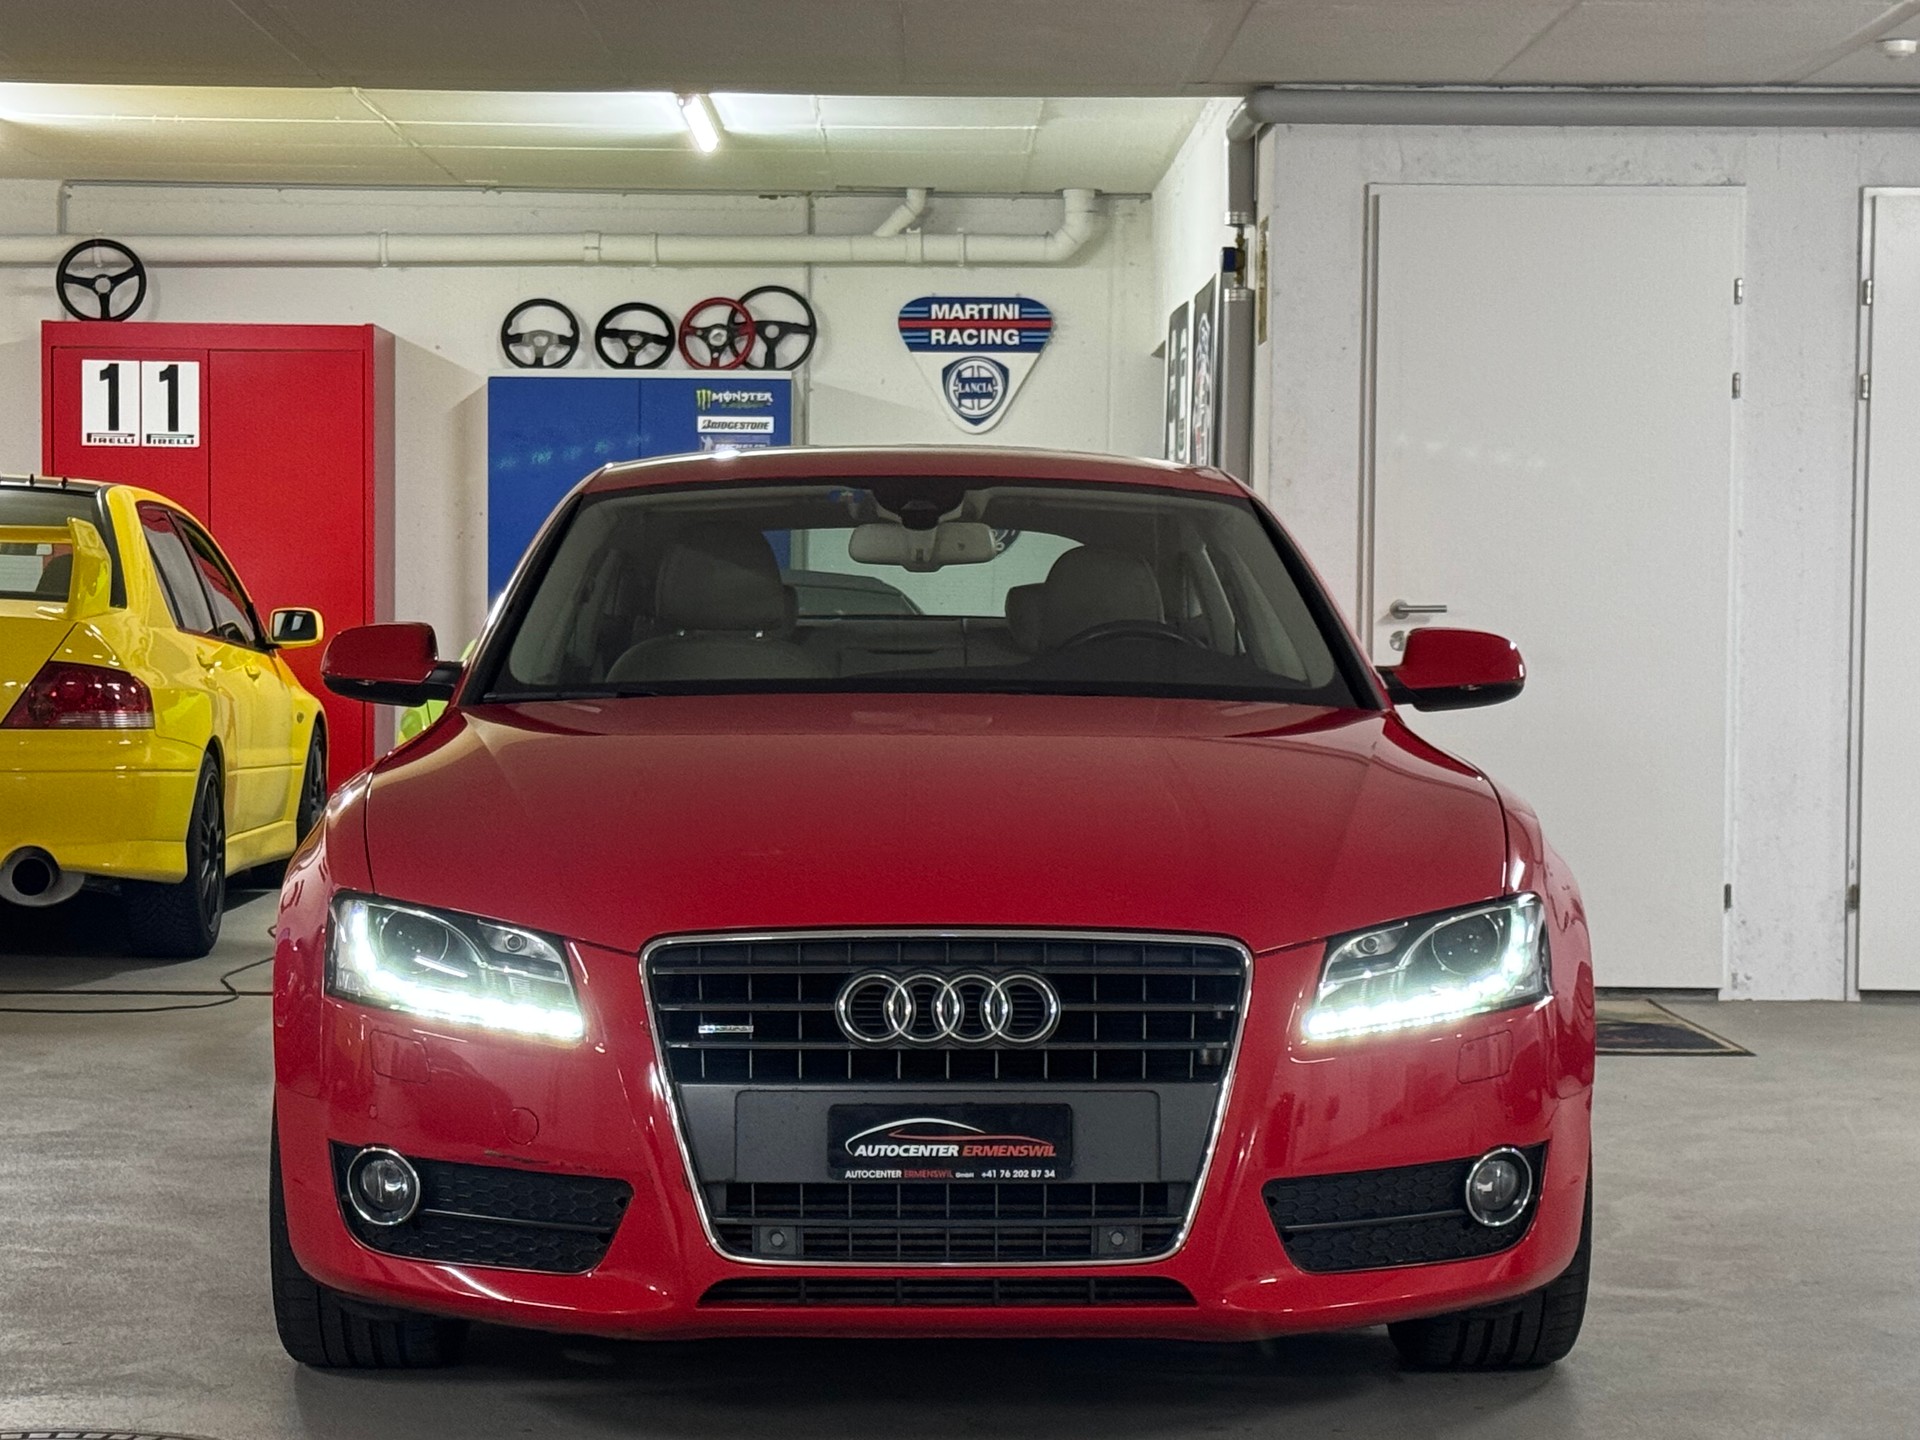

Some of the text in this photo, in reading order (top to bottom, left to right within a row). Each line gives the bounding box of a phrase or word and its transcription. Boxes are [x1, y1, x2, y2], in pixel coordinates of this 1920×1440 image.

[930, 303, 1020, 320] MARTINI
[930, 328, 1020, 346] RACING
[957, 382, 994, 393] LANCIA
[711, 390, 774, 402] MONSTER
[701, 418, 770, 430] BRIDGESTONE
[86, 433, 136, 444] PIRELLI
[146, 433, 195, 445] PIRELLI
[854, 1144, 1057, 1157] AUTOCENTER ERMENSWIL
[844, 1169, 902, 1179] AUTOCENTER
[904, 1169, 954, 1178] ERMENSWIL
[981, 1169, 997, 1179] +41
[999, 1169, 1011, 1179] 76
[1012, 1169, 1029, 1179] 202
[1030, 1169, 1042, 1179] 87
[1043, 1169, 1056, 1179] 34
